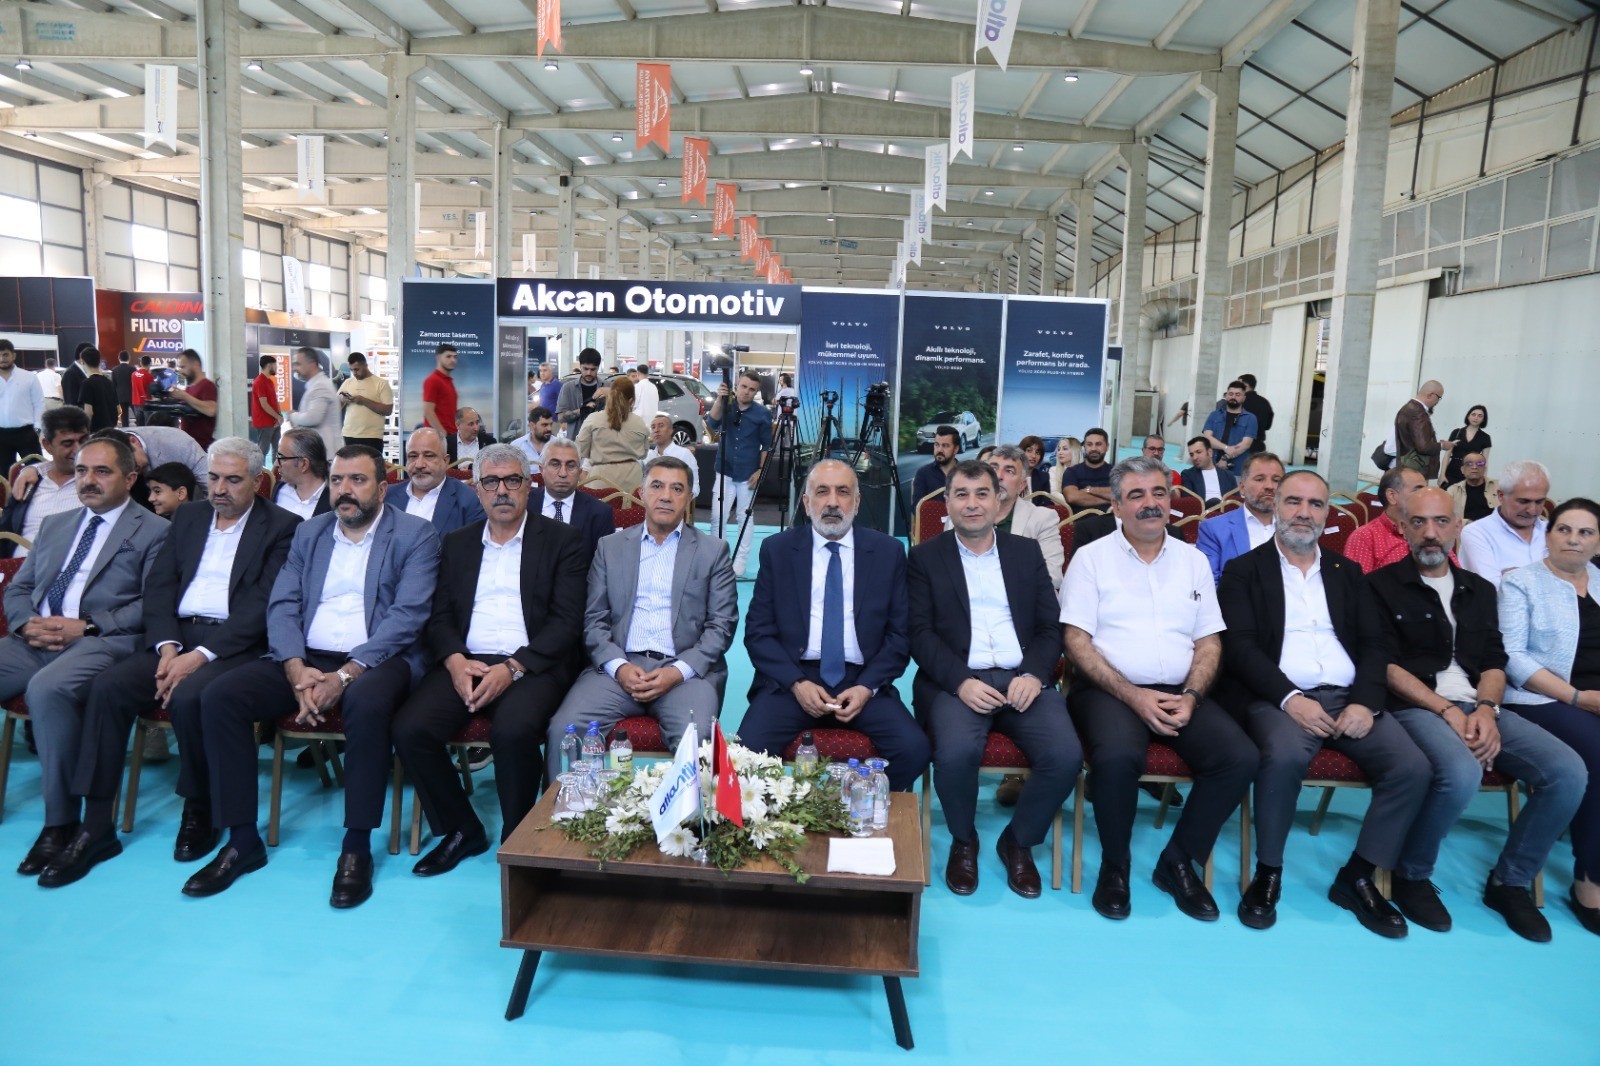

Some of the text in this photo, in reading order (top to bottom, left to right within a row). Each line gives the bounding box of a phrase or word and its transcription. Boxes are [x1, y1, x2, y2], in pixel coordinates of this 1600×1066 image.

[512, 283, 785, 316] Akcan Otomotiv
[131, 318, 185, 333] FILTRO
[419, 330, 478, 339] Zamansız tasarım,
[147, 340, 184, 351] Autop
[825, 340, 872, 351] İleri teknoloji,
[818, 351, 857, 359] mükemmel
[944, 347, 977, 355] teknoloji,
[1023, 350, 1051, 359] Zarafet,
[915, 354, 986, 364] dinamik performans.
[659, 759, 698, 816] atlantik
